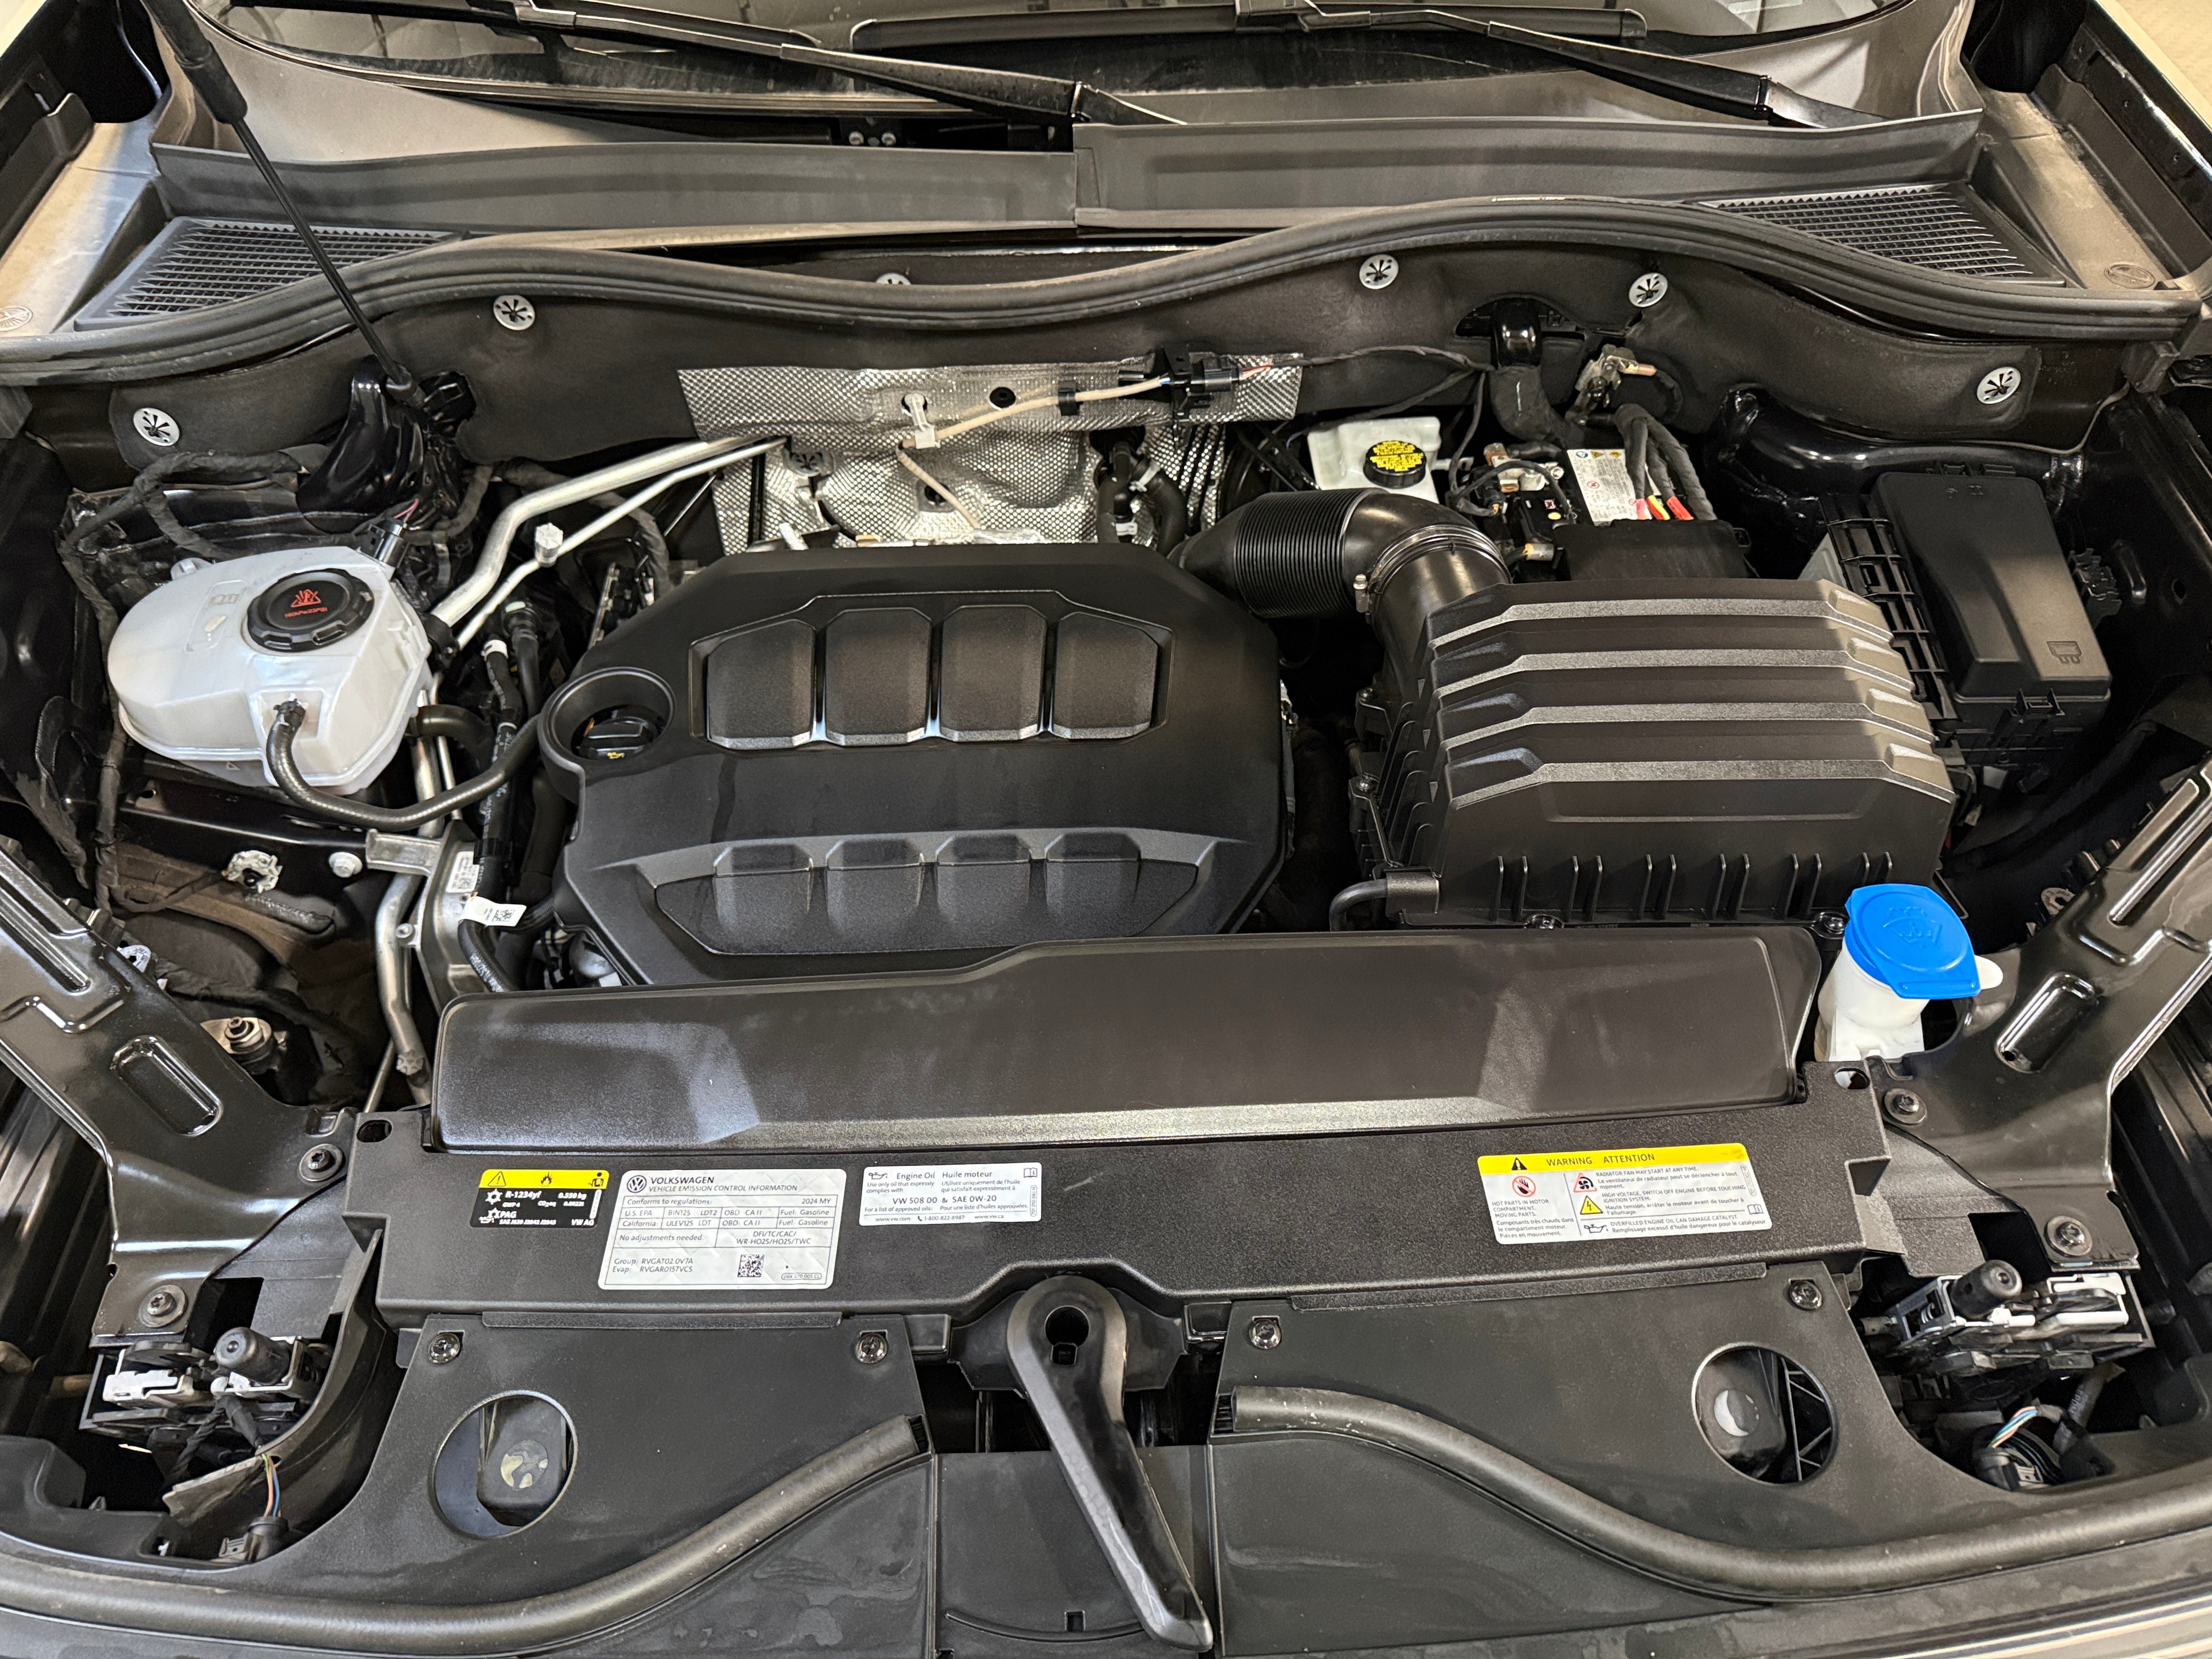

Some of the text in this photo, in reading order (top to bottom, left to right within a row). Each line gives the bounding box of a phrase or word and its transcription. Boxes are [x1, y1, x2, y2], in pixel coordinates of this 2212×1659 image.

[1546, 1153, 1655, 1166] WARNING ATTENTION
[896, 1172, 923, 1181] Engine
[505, 1190, 542, 1199] R-1234yf
